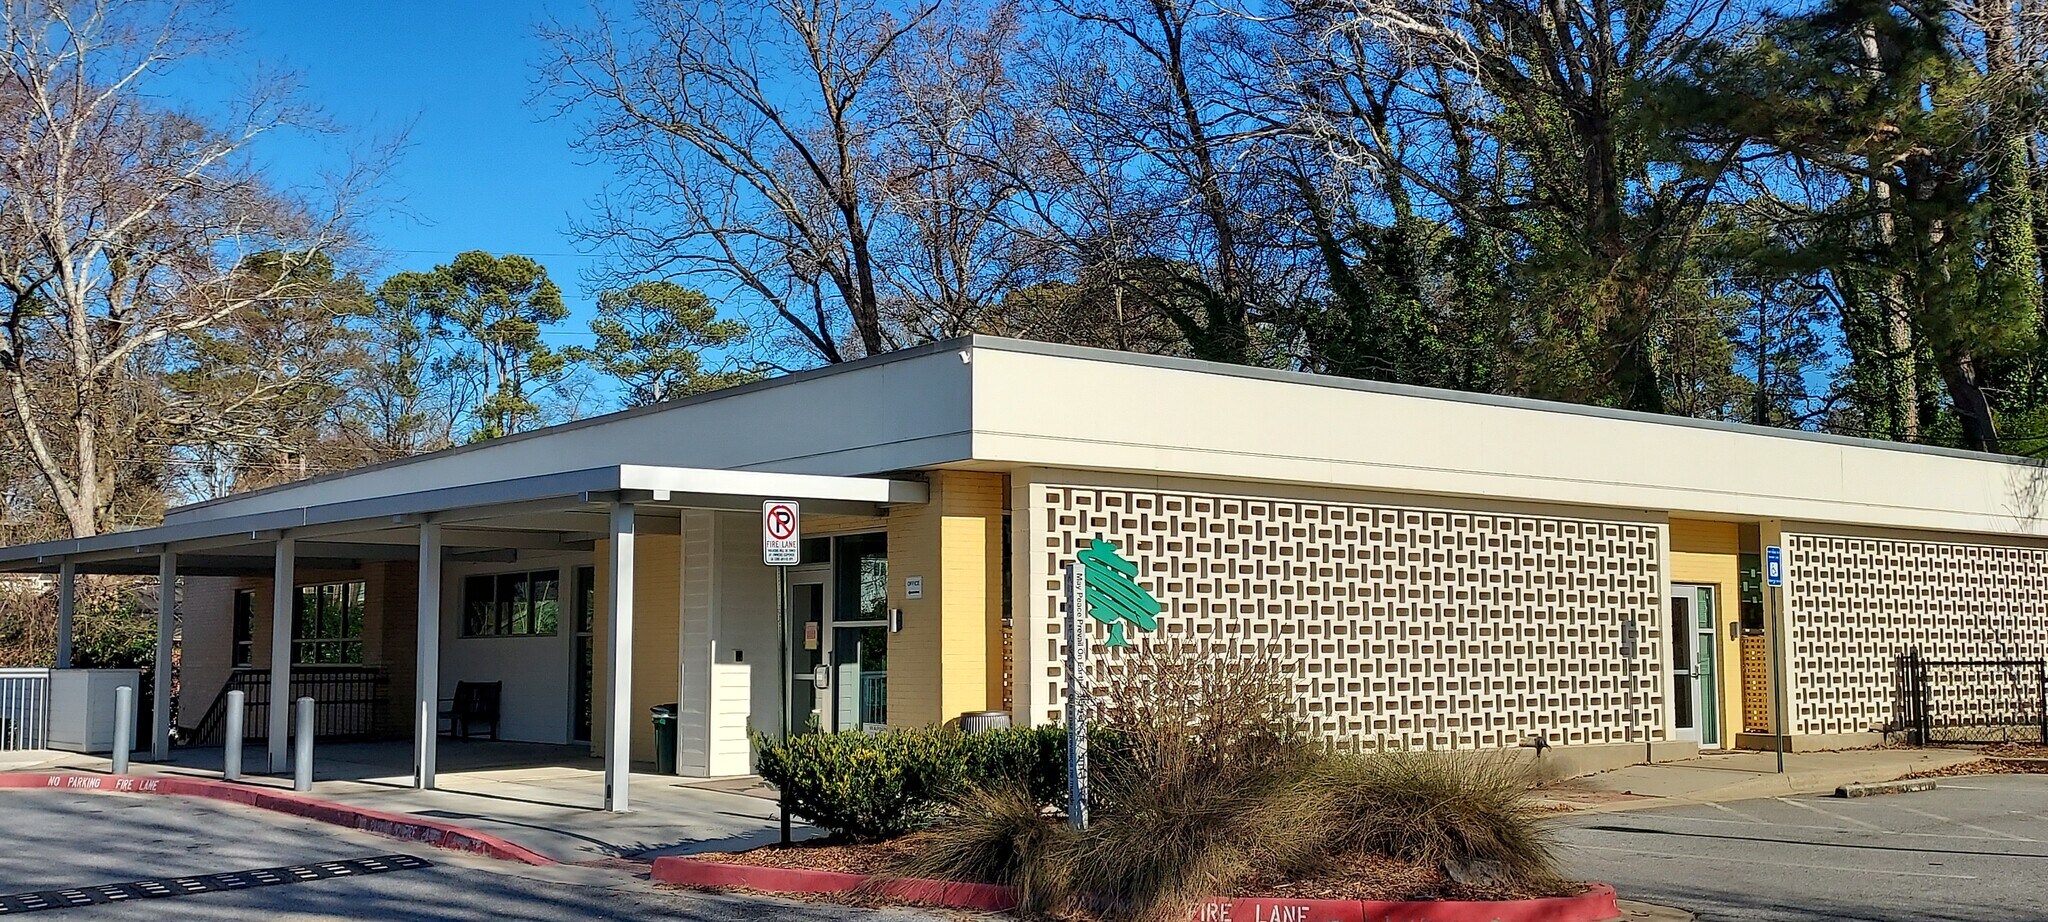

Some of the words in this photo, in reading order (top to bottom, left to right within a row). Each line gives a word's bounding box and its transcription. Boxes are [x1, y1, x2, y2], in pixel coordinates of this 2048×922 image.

[1077, 648, 1083, 660] On
[48, 776, 60, 786] NO
[68, 777, 101, 788] PARKING
[116, 779, 133, 790] FIRE
[139, 780, 159, 791] LANE
[1189, 902, 1232, 922] IRE
